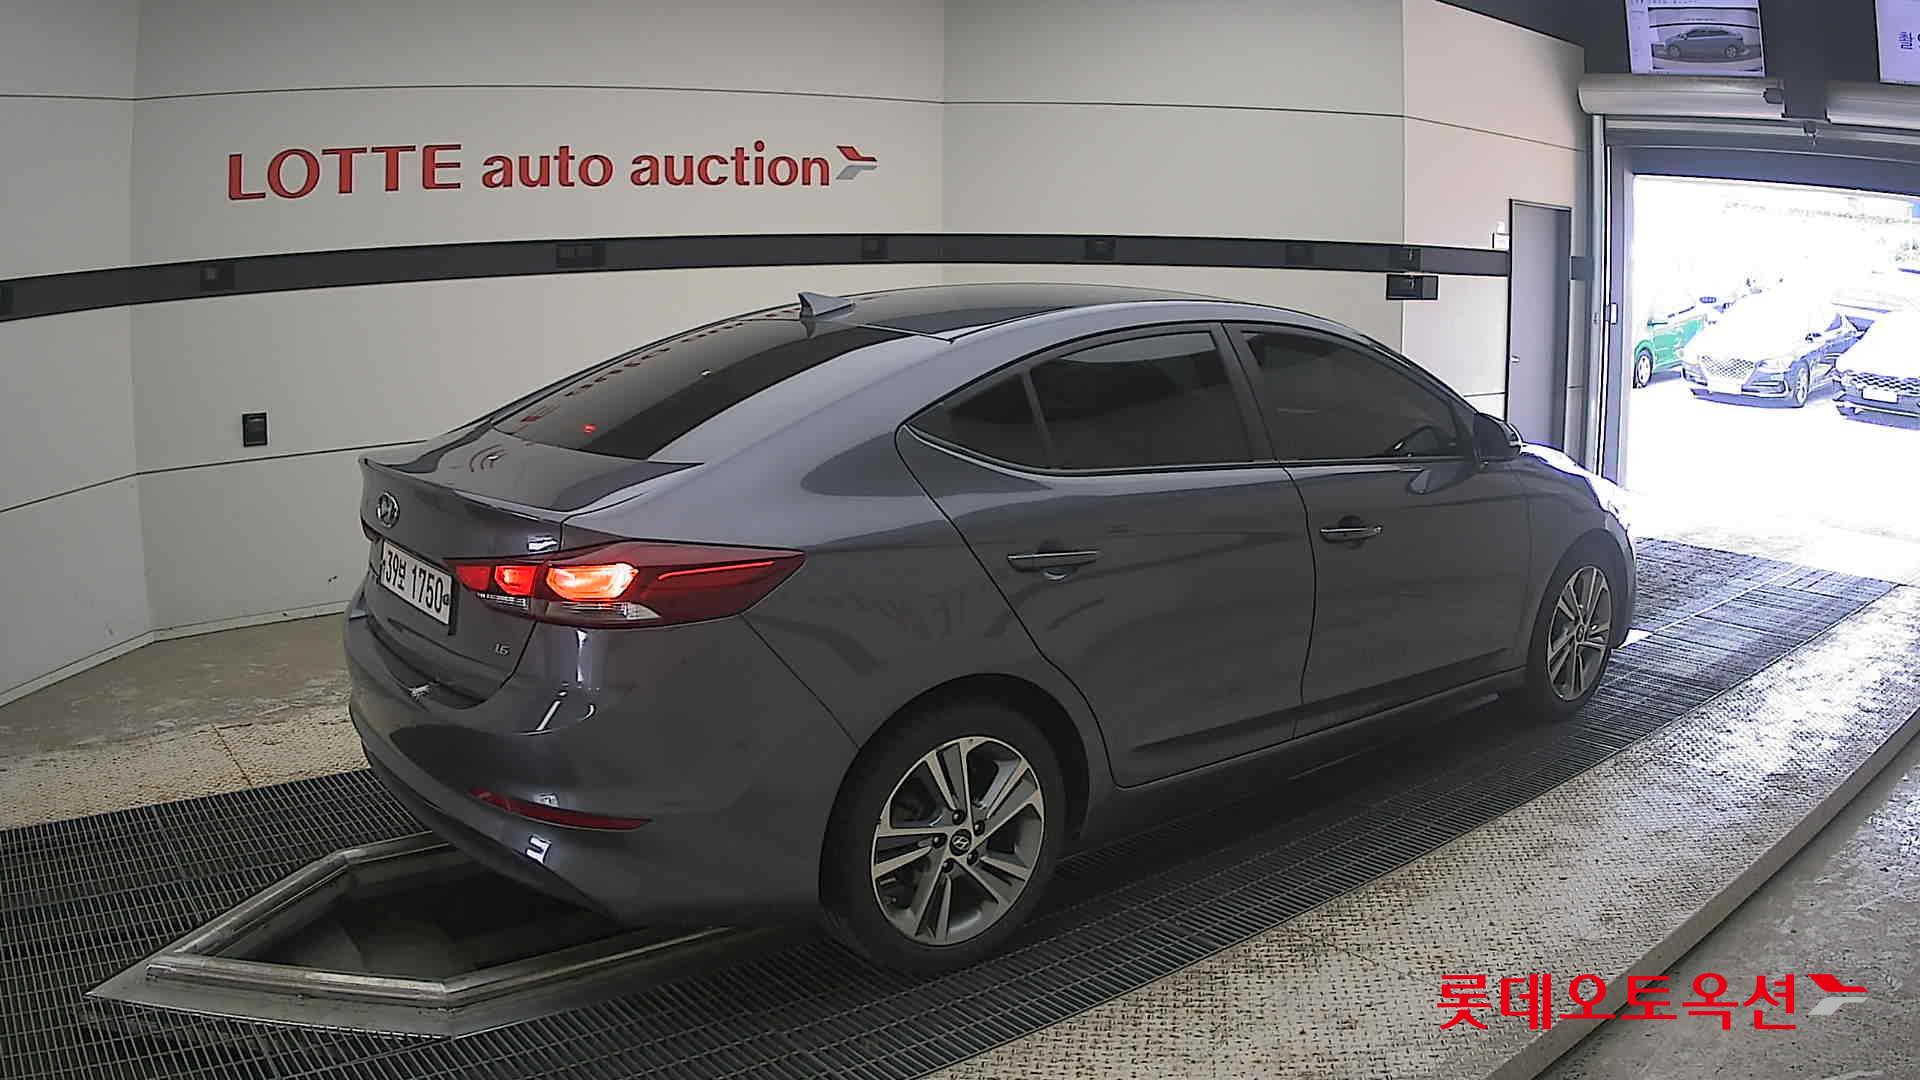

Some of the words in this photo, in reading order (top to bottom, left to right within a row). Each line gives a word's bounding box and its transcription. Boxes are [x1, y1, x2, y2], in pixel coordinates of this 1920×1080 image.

[1898, 31, 1920, 50] 촬
[227, 143, 463, 201] LOTTE
[481, 145, 614, 189] auto
[630, 140, 830, 187] auction
[411, 564, 444, 614] 1750
